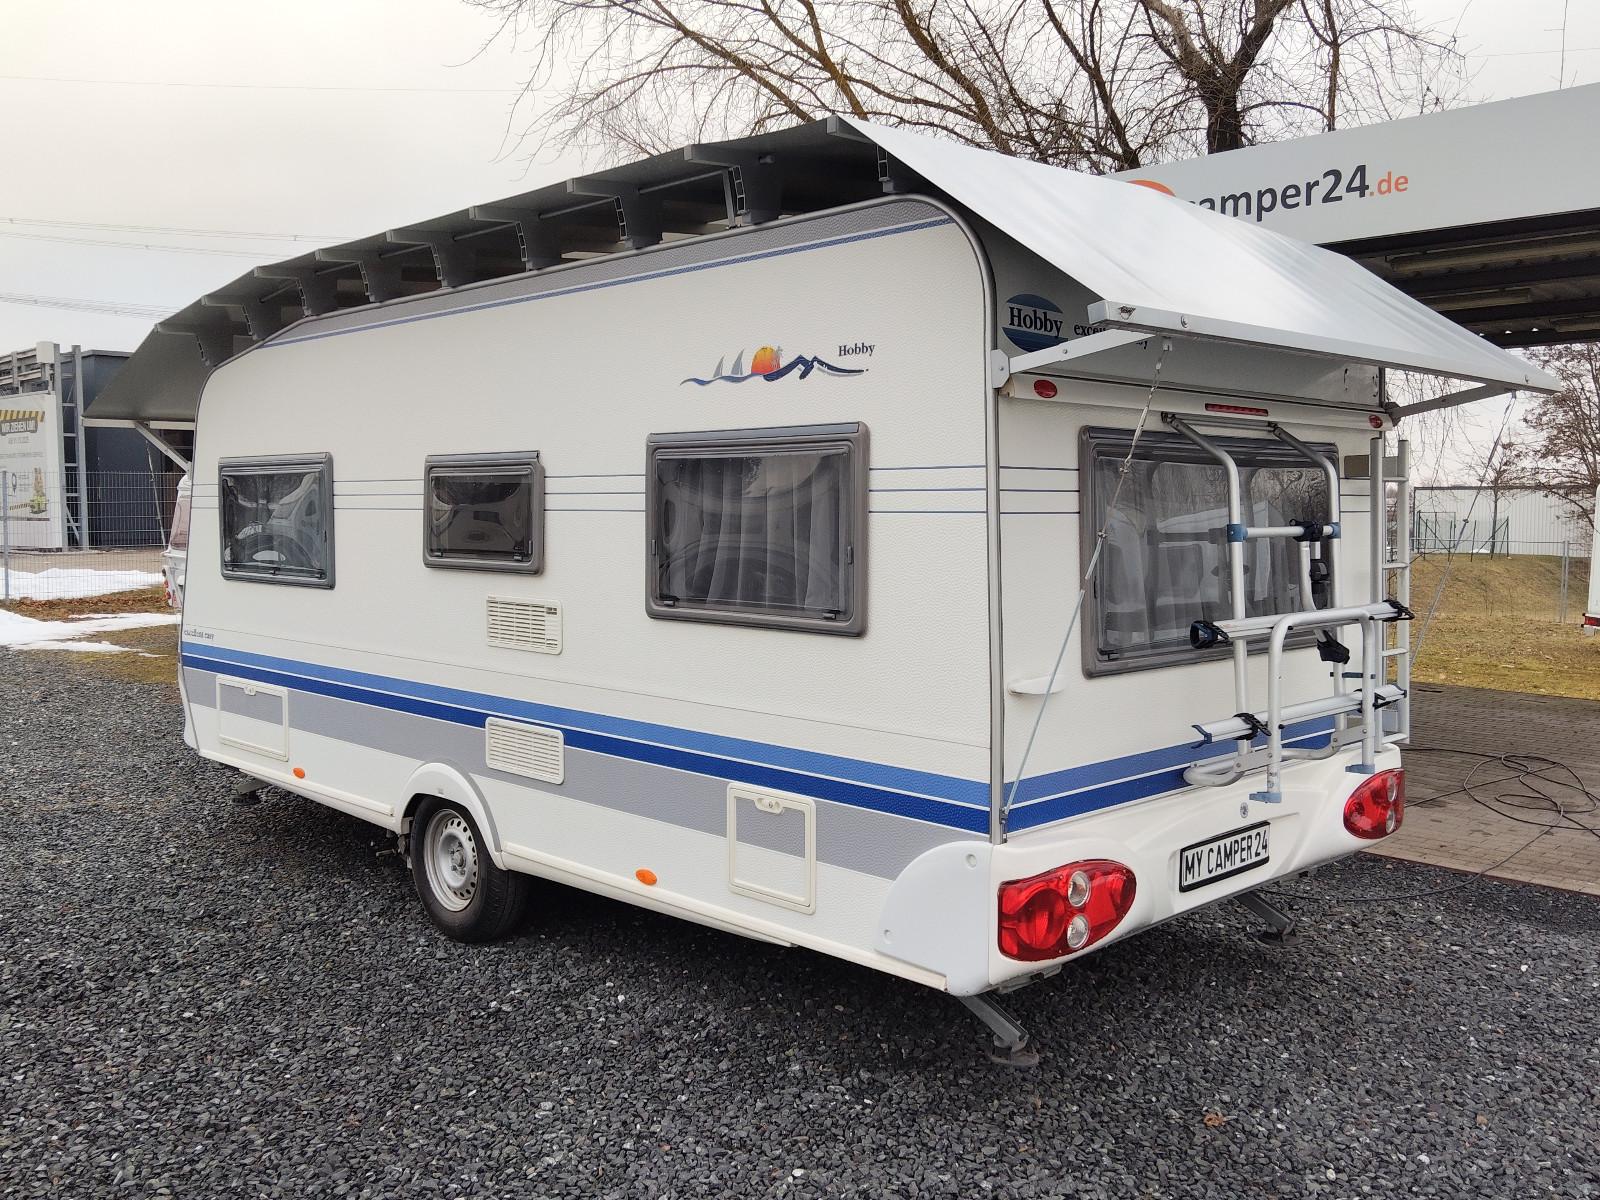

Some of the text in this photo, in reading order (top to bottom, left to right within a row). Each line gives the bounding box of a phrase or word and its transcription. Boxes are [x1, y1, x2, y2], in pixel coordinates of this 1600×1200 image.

[1008, 306, 1063, 337] Hobby
[838, 342, 876, 357] Hobby
[1185, 829, 1268, 882] MY CAMPER 24
